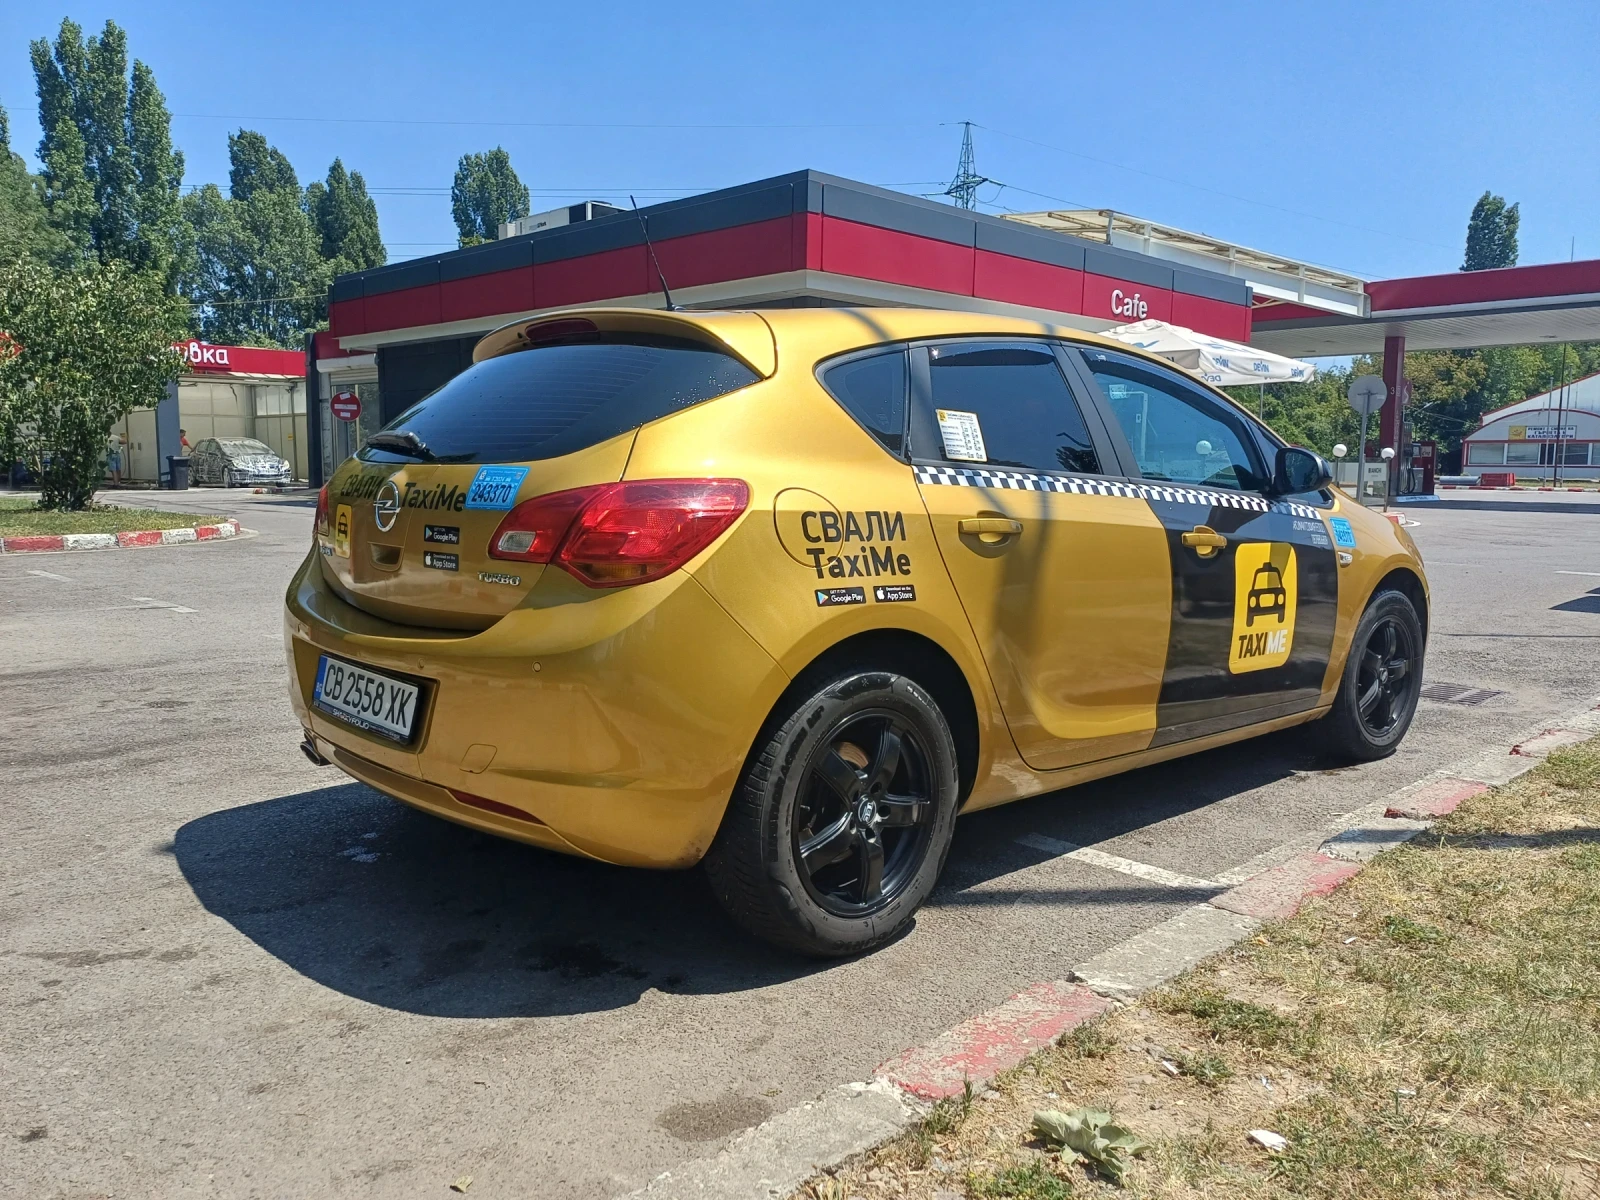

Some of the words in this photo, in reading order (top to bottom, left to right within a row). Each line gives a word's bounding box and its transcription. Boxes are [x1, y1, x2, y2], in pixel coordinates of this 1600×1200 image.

[1111, 290, 1148, 318] Cafe
[402, 482, 467, 512] TaxiMe
[471, 483, 513, 503] 243370
[433, 532, 448, 542] Google
[448, 533, 458, 543] Play
[800, 510, 907, 543] СВАЛИ
[433, 559, 442, 569] App
[443, 560, 456, 569] Store
[805, 545, 912, 579] TaxiMe
[477, 571, 520, 587] TURBO
[830, 594, 851, 603] Google
[852, 593, 863, 602] Play
[887, 591, 898, 601] App
[899, 591, 913, 600] Store
[1238, 629, 1288, 660] TAXIME
[324, 664, 344, 701] CB
[342, 671, 385, 717] 2558
[384, 685, 413, 728] XK
